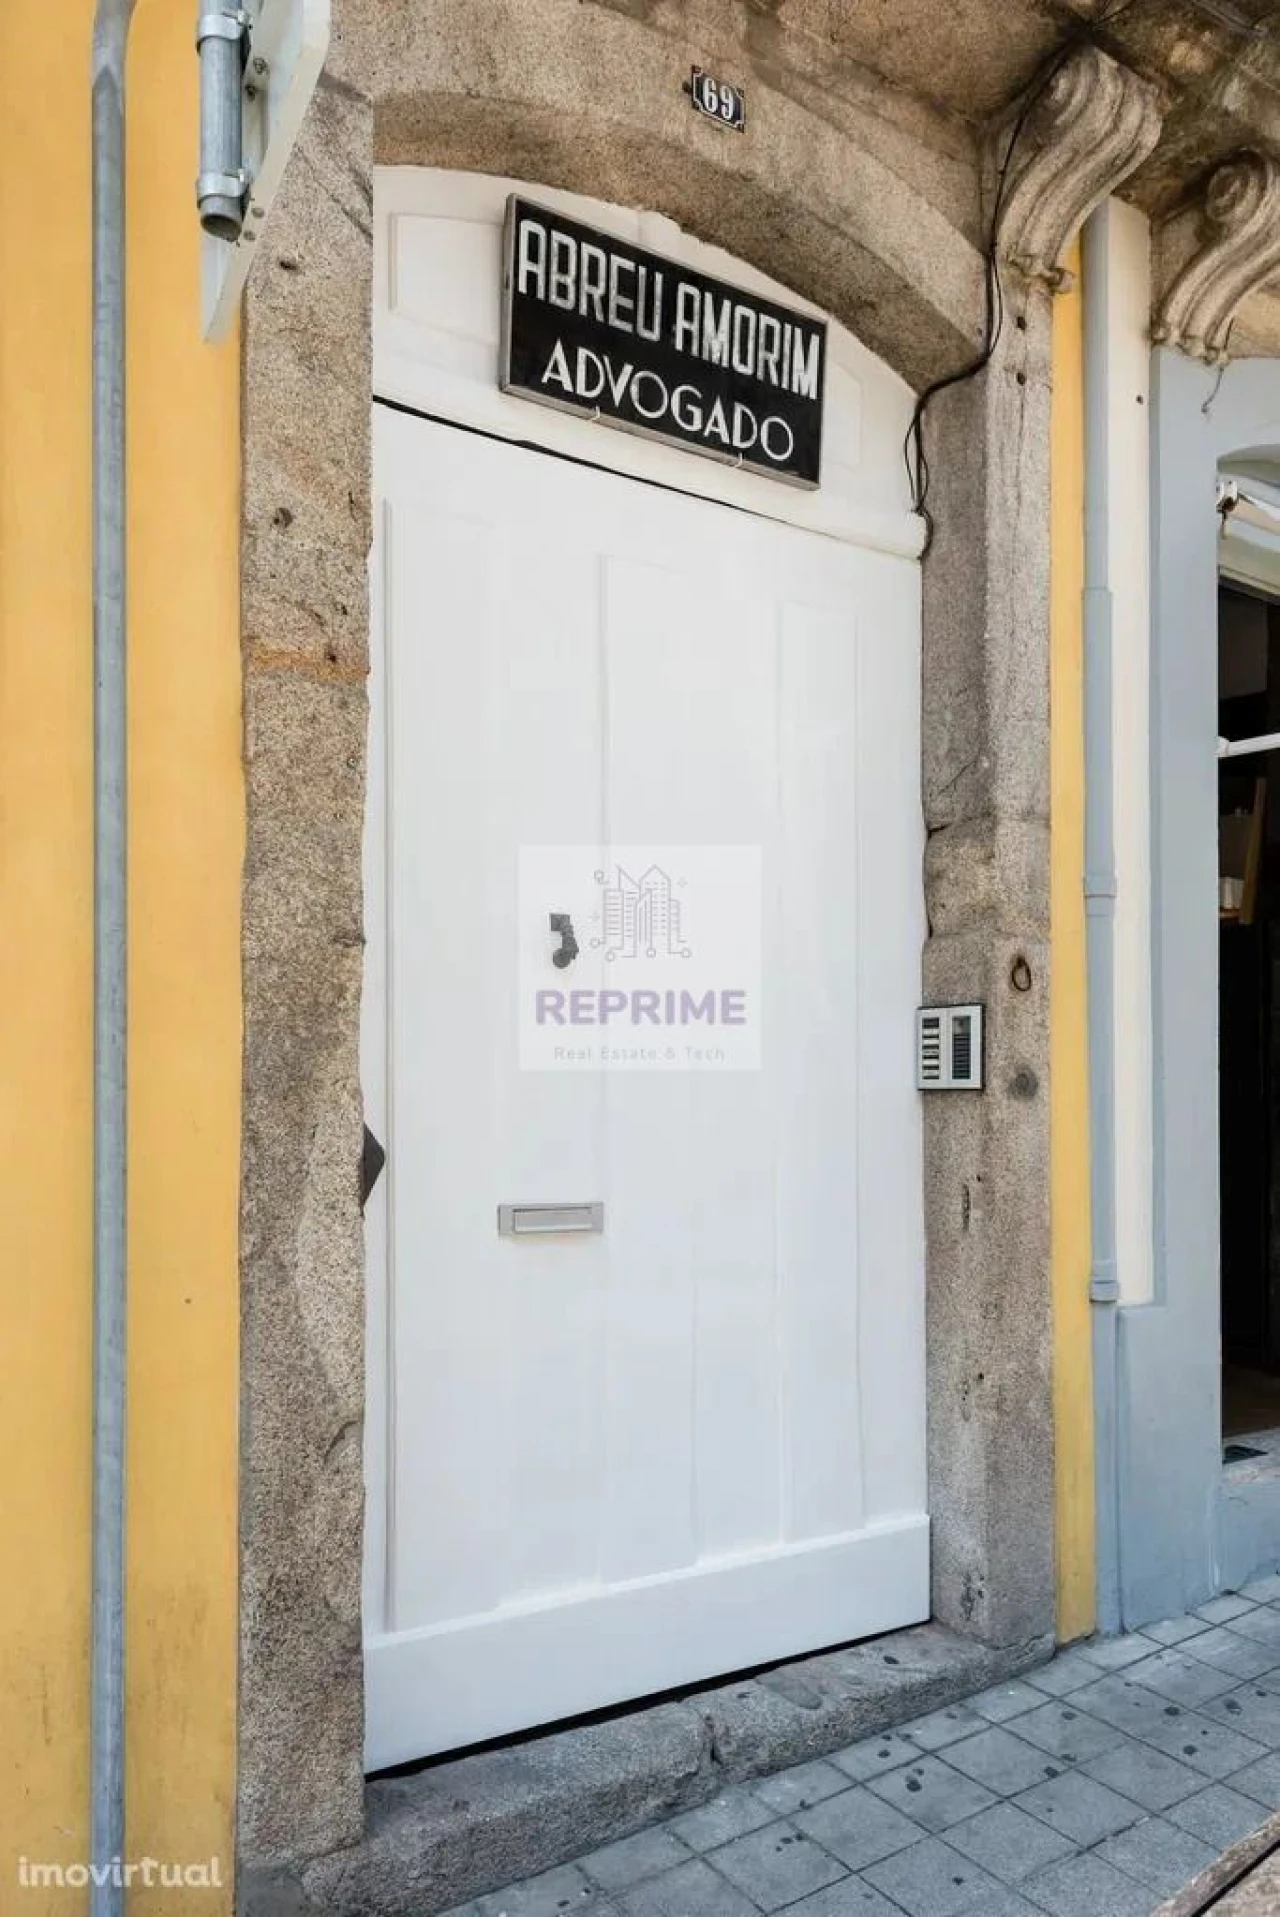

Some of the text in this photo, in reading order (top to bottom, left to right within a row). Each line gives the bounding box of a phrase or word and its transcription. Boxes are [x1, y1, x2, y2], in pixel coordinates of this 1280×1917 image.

[702, 78, 735, 120] 69
[518, 219, 821, 401] ABREU AMORIM
[541, 336, 794, 461] ADVOGADO
